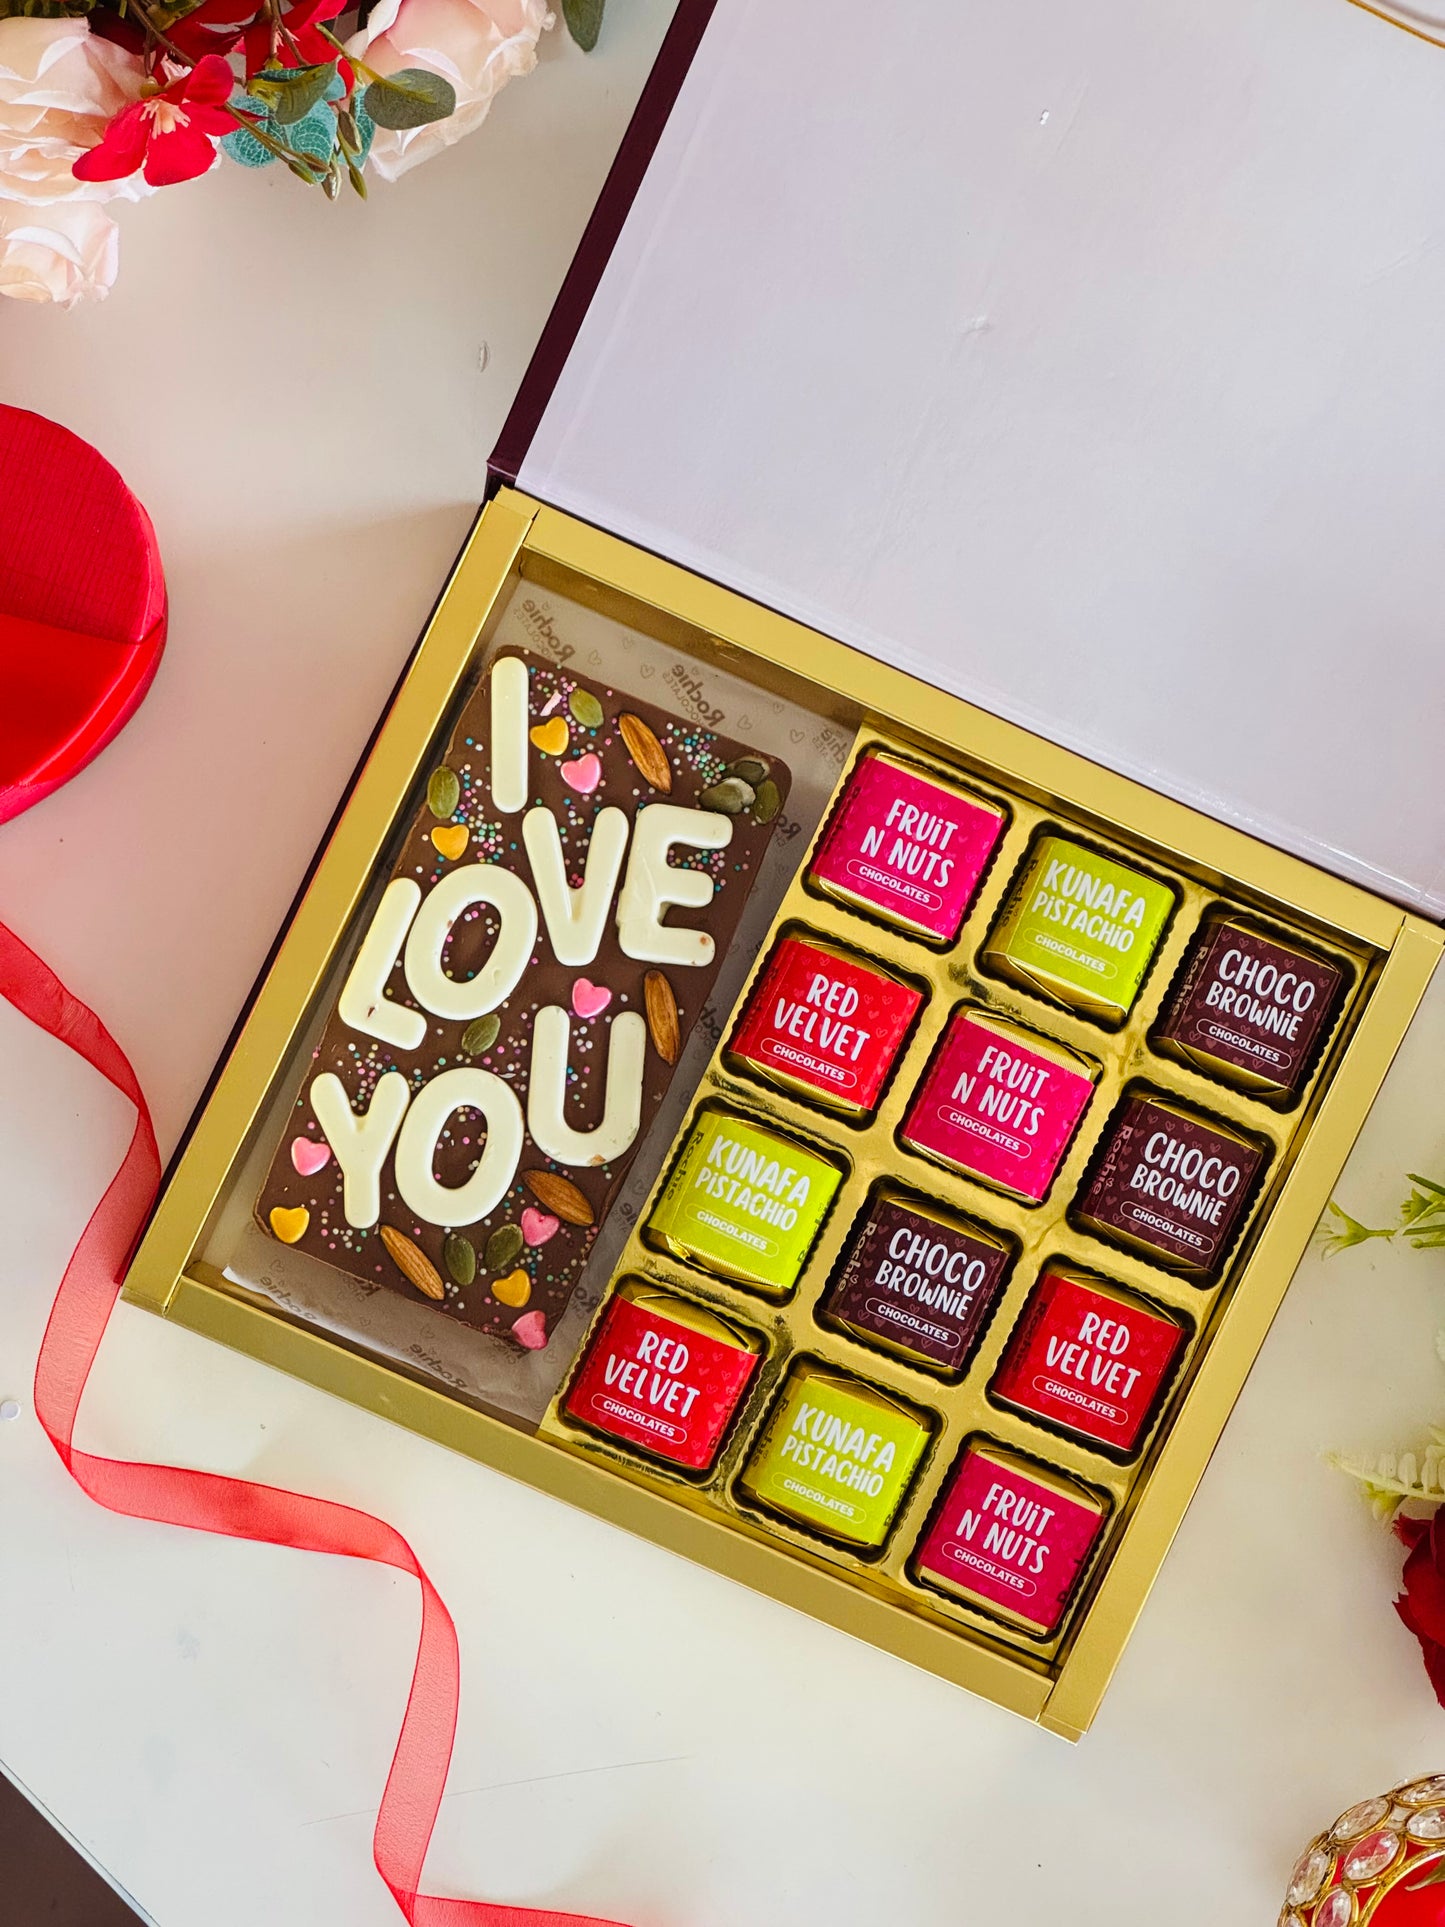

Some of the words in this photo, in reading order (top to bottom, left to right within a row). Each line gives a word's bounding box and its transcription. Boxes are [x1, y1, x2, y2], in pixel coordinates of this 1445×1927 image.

[491, 656, 528, 813] I
[859, 865, 931, 904] CHOCOLATES
[860, 826, 886, 858] N
[887, 837, 954, 888] NUTS
[1043, 859, 1146, 928] KUNAFA
[338, 803, 733, 1050] LOVE
[1035, 934, 1106, 973] CHOCOLATES
[806, 973, 859, 1018] RED
[1172, 947, 1209, 1016] Rochie
[1219, 949, 1316, 1013] CHOCO
[773, 1043, 845, 1081] CHOCOLATES
[774, 998, 871, 1062] VELVET
[1208, 1025, 1280, 1062] CHOCOLATES
[309, 1005, 646, 1228] YOU
[949, 1111, 1021, 1152] CHOCOLATES
[951, 1072, 978, 1105] N
[979, 1085, 1045, 1136] NUTS
[667, 1131, 705, 1201] Rochie
[706, 1135, 811, 1207] KUNAFA
[1090, 1124, 1134, 1195] Rochie
[1144, 1132, 1241, 1198] CHOCO
[696, 1210, 768, 1250] CHOCOLATES
[837, 1220, 878, 1292] Rochie
[1132, 1207, 1204, 1247] CHOCOLATES
[888, 1228, 986, 1292] CHOCO
[636, 1330, 689, 1375] RED
[877, 1304, 950, 1342] CHOCOLATES
[1077, 1311, 1130, 1355] RED
[604, 1353, 700, 1418] VELVET
[1046, 1335, 1141, 1399] VELVET
[602, 1399, 675, 1437] CHOCOLATES
[1044, 1381, 1116, 1419] CHOCOLATES
[792, 1402, 896, 1473] KUNAFA
[783, 1478, 855, 1517] CHOCOLATES
[954, 1548, 1025, 1590] CHOCOLATES
[956, 1509, 982, 1541] N
[982, 1522, 1050, 1574] NUTS
